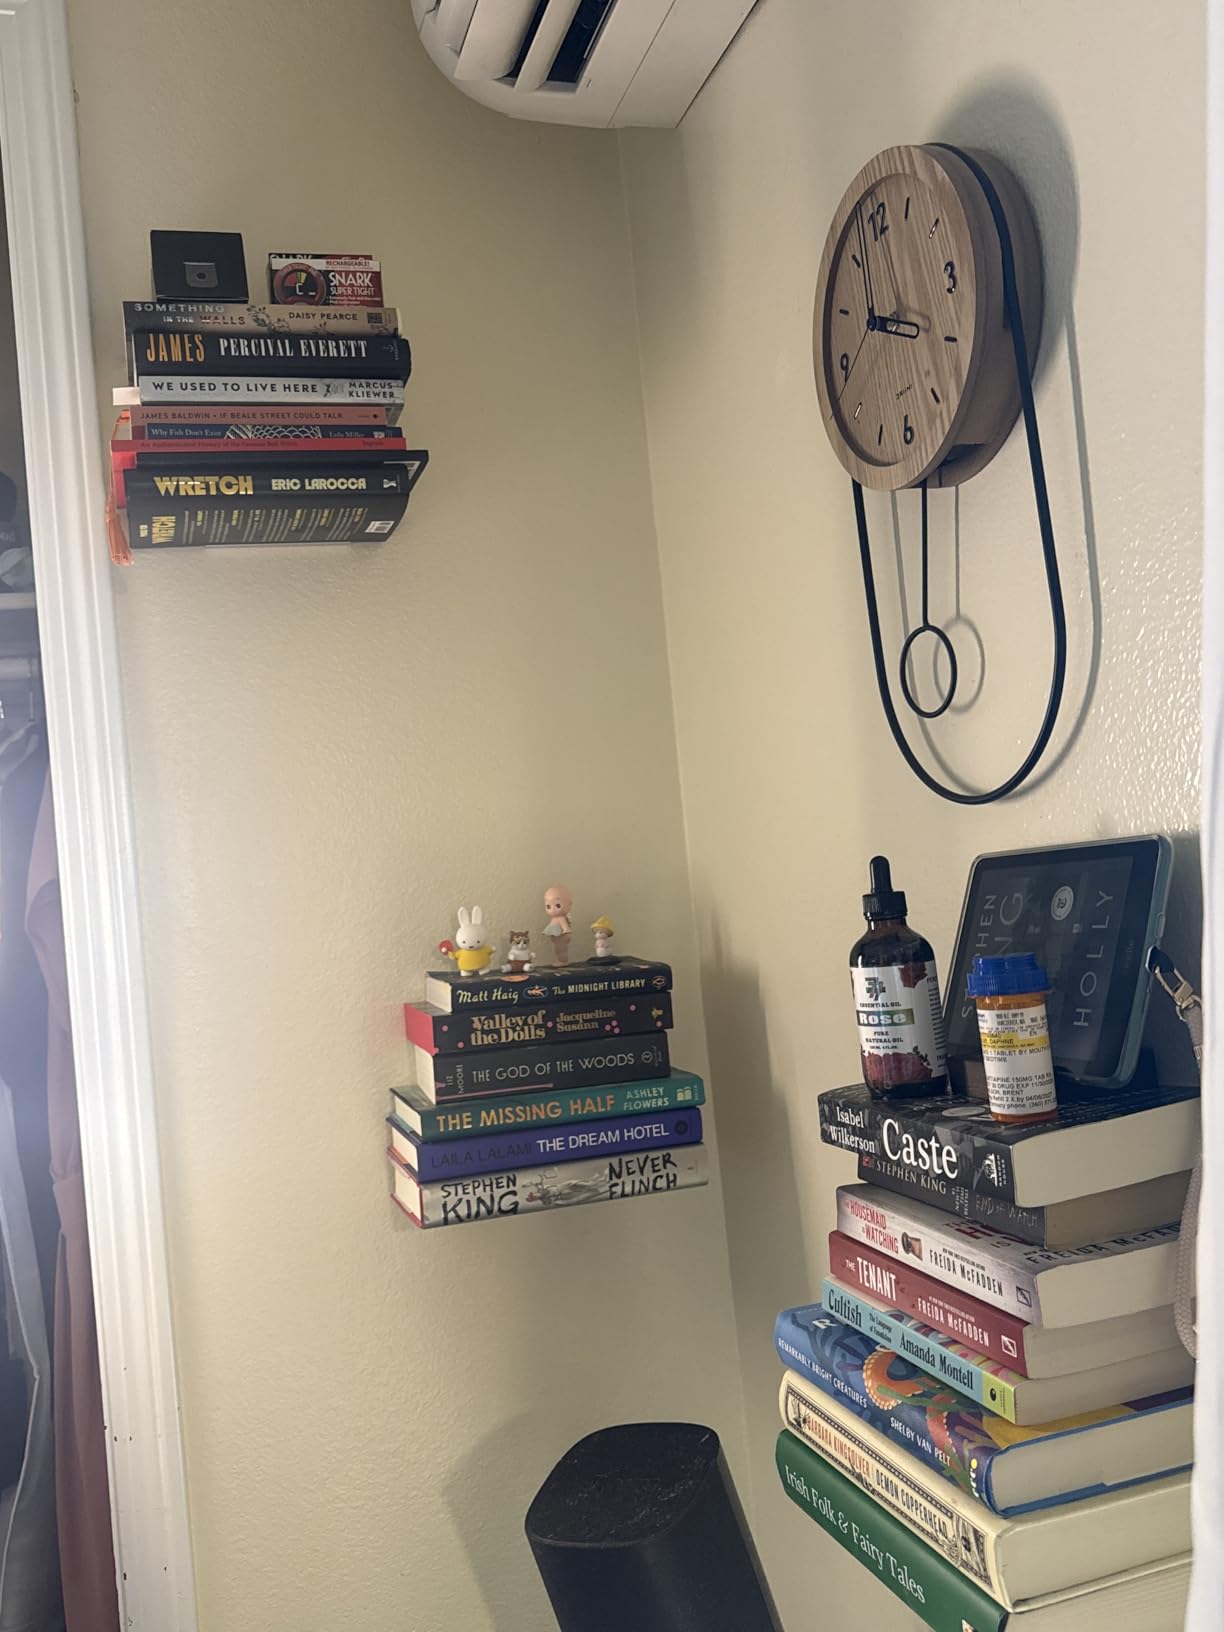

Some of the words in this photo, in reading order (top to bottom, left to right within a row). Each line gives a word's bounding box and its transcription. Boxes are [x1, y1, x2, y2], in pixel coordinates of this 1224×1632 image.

[868, 202, 889, 242] 12
[329, 272, 373, 288] SNARK
[330, 286, 352, 296] SUPER
[353, 287, 375, 296] TIGHT
[944, 261, 957, 294] 3
[134, 303, 225, 313] SOMETHING
[162, 315, 173, 323] IN
[175, 315, 195, 323] THE
[199, 315, 247, 325] WALLS
[288, 311, 317, 320] DAISY
[321, 312, 358, 321] PEARCE
[147, 332, 205, 362] JAMES
[219, 337, 294, 357] PERCIVAL
[300, 339, 368, 358] EVERETT
[840, 352, 849, 383] 9
[152, 381, 174, 391] WE
[180, 381, 217, 392] USED
[221, 382, 241, 392] TO
[246, 383, 277, 393] LIVE
[283, 383, 319, 393] HERE
[348, 381, 393, 390] MARCUS
[348, 390, 395, 399] KLIEWER
[140, 412, 169, 420] JAMES
[172, 412, 210, 420] BALDWIN
[294, 412, 321, 420] COULD
[903, 414, 914, 445] 6
[151, 428, 168, 437] Why
[169, 428, 184, 437] Fish
[153, 475, 254, 496] WRETCH
[271, 478, 301, 490] ERIC
[304, 477, 367, 490] LAROCCA
[962, 894, 999, 1018] SHEN
[1073, 890, 1113, 1027] HOLLY
[456, 989, 488, 1004] Matt
[492, 987, 519, 1004] Haig
[552, 985, 566, 995] The
[568, 981, 609, 994] MIDNIGHT
[611, 978, 646, 990] LIBRARY
[470, 1013, 526, 1031] Valley
[527, 1009, 547, 1026] of
[556, 1008, 616, 1022] Jacqueline
[556, 1020, 599, 1033] Susann
[470, 1029, 499, 1046] the
[500, 1025, 546, 1042] Dolls
[993, 1049, 1016, 1057] TABLET
[456, 1064, 464, 1094] MOORE
[472, 1069, 491, 1084] THE
[495, 1064, 530, 1080] GOD
[534, 1061, 552, 1076] OF
[556, 1060, 574, 1073] THE
[578, 1052, 635, 1069] WOODS
[623, 1097, 669, 1112] FLOWERS
[626, 1086, 665, 1100] ASHLEY
[436, 1111, 473, 1132] THE
[479, 1101, 563, 1127] MISSING
[569, 1093, 615, 1116] HALF
[835, 1106, 864, 1129] Isabel
[536, 1137, 565, 1153] THE
[568, 1129, 621, 1149] DREAM
[623, 1123, 670, 1141] HOTEL
[829, 1125, 876, 1154] Wilkerson
[882, 1118, 959, 1179] Caste
[431, 1150, 473, 1169] LAILA
[477, 1143, 532, 1161] LALAMI
[608, 1152, 678, 1181] NEVER
[440, 1173, 518, 1199] STEPHEN
[608, 1172, 678, 1200] FLINCH
[876, 1160, 917, 1184] STEPHEN
[920, 1174, 947, 1195] KING
[441, 1190, 520, 1225] KING
[850, 1201, 887, 1230] HOUSEMAID
[865, 1224, 899, 1254] WATCHING
[1025, 1243, 1108, 1264] FREIDA
[845, 1258, 856, 1272] THE
[856, 1256, 896, 1302] TENANT
[929, 1249, 957, 1275] FREIDA
[960, 1264, 1003, 1297] McFADDEN
[828, 1288, 862, 1329] Cultish
[917, 1297, 944, 1324] FREIDA
[947, 1312, 990, 1347] McFADDEN
[777, 1337, 812, 1368] REMARKABLY
[811, 1362, 832, 1384] BRIGHT
[833, 1377, 868, 1409] CREATURES
[899, 1332, 936, 1369] Amanda
[939, 1353, 974, 1390] Montell
[890, 1416, 915, 1442] SHELBY
[916, 1434, 932, 1454] VAN
[934, 1447, 951, 1467] PELT
[833, 1436, 870, 1478] KINGSOLVER
[875, 1468, 899, 1500] DEMON
[901, 1488, 948, 1540] COPPERHEAD
[784, 1464, 811, 1501] Irish
[811, 1487, 837, 1526] Folk
[838, 1511, 849, 1534] &
[850, 1522, 884, 1570] Fairy
[886, 1552, 926, 1604] Tales
